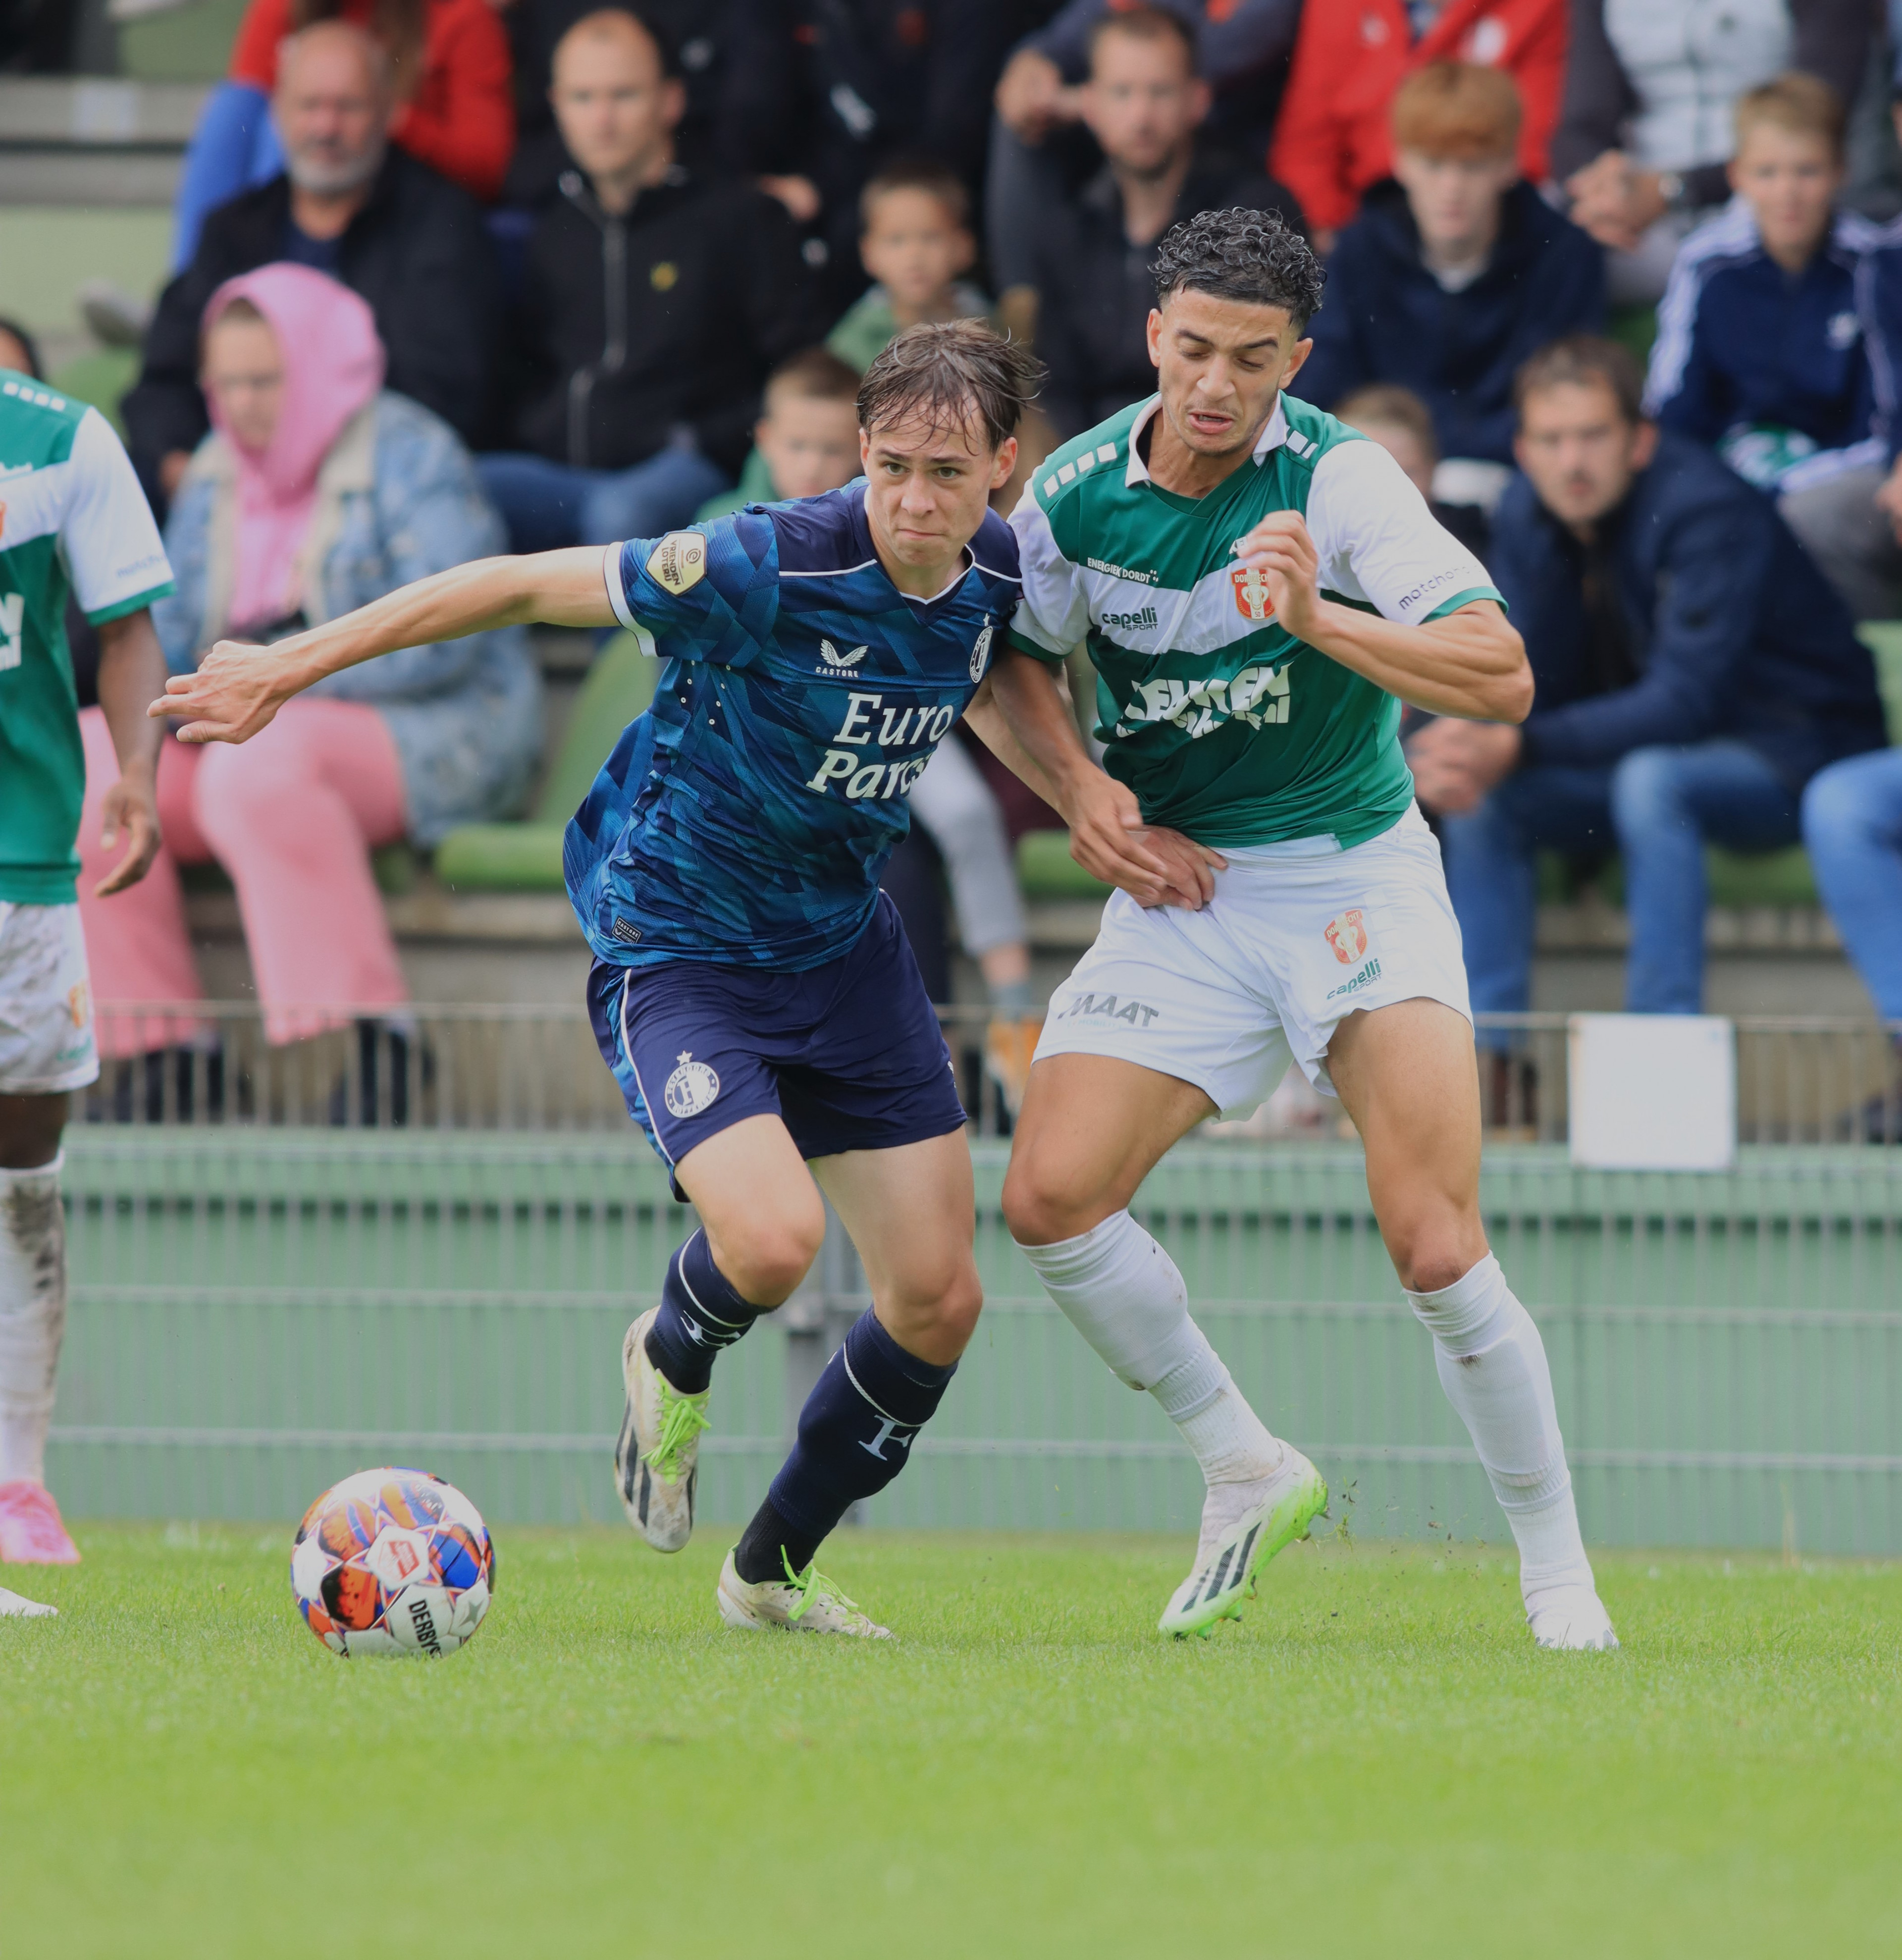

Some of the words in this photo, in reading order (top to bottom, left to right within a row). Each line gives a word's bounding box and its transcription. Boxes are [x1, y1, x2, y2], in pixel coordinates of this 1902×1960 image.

[669, 539, 681, 585] VRIENDEN
[1087, 557, 1122, 577] ENERGIEK
[1122, 568, 1150, 583] DORDT
[1234, 573, 1268, 583] DORDRECH
[1102, 607, 1158, 629] capelli
[815, 666, 858, 678] CASTORE
[833, 692, 953, 746] Euro
[617, 921, 638, 938] CASTORE
[1326, 958, 1381, 1000] capelli
[1354, 973, 1382, 992] SPORT
[1057, 994, 1160, 1027] MAAT
